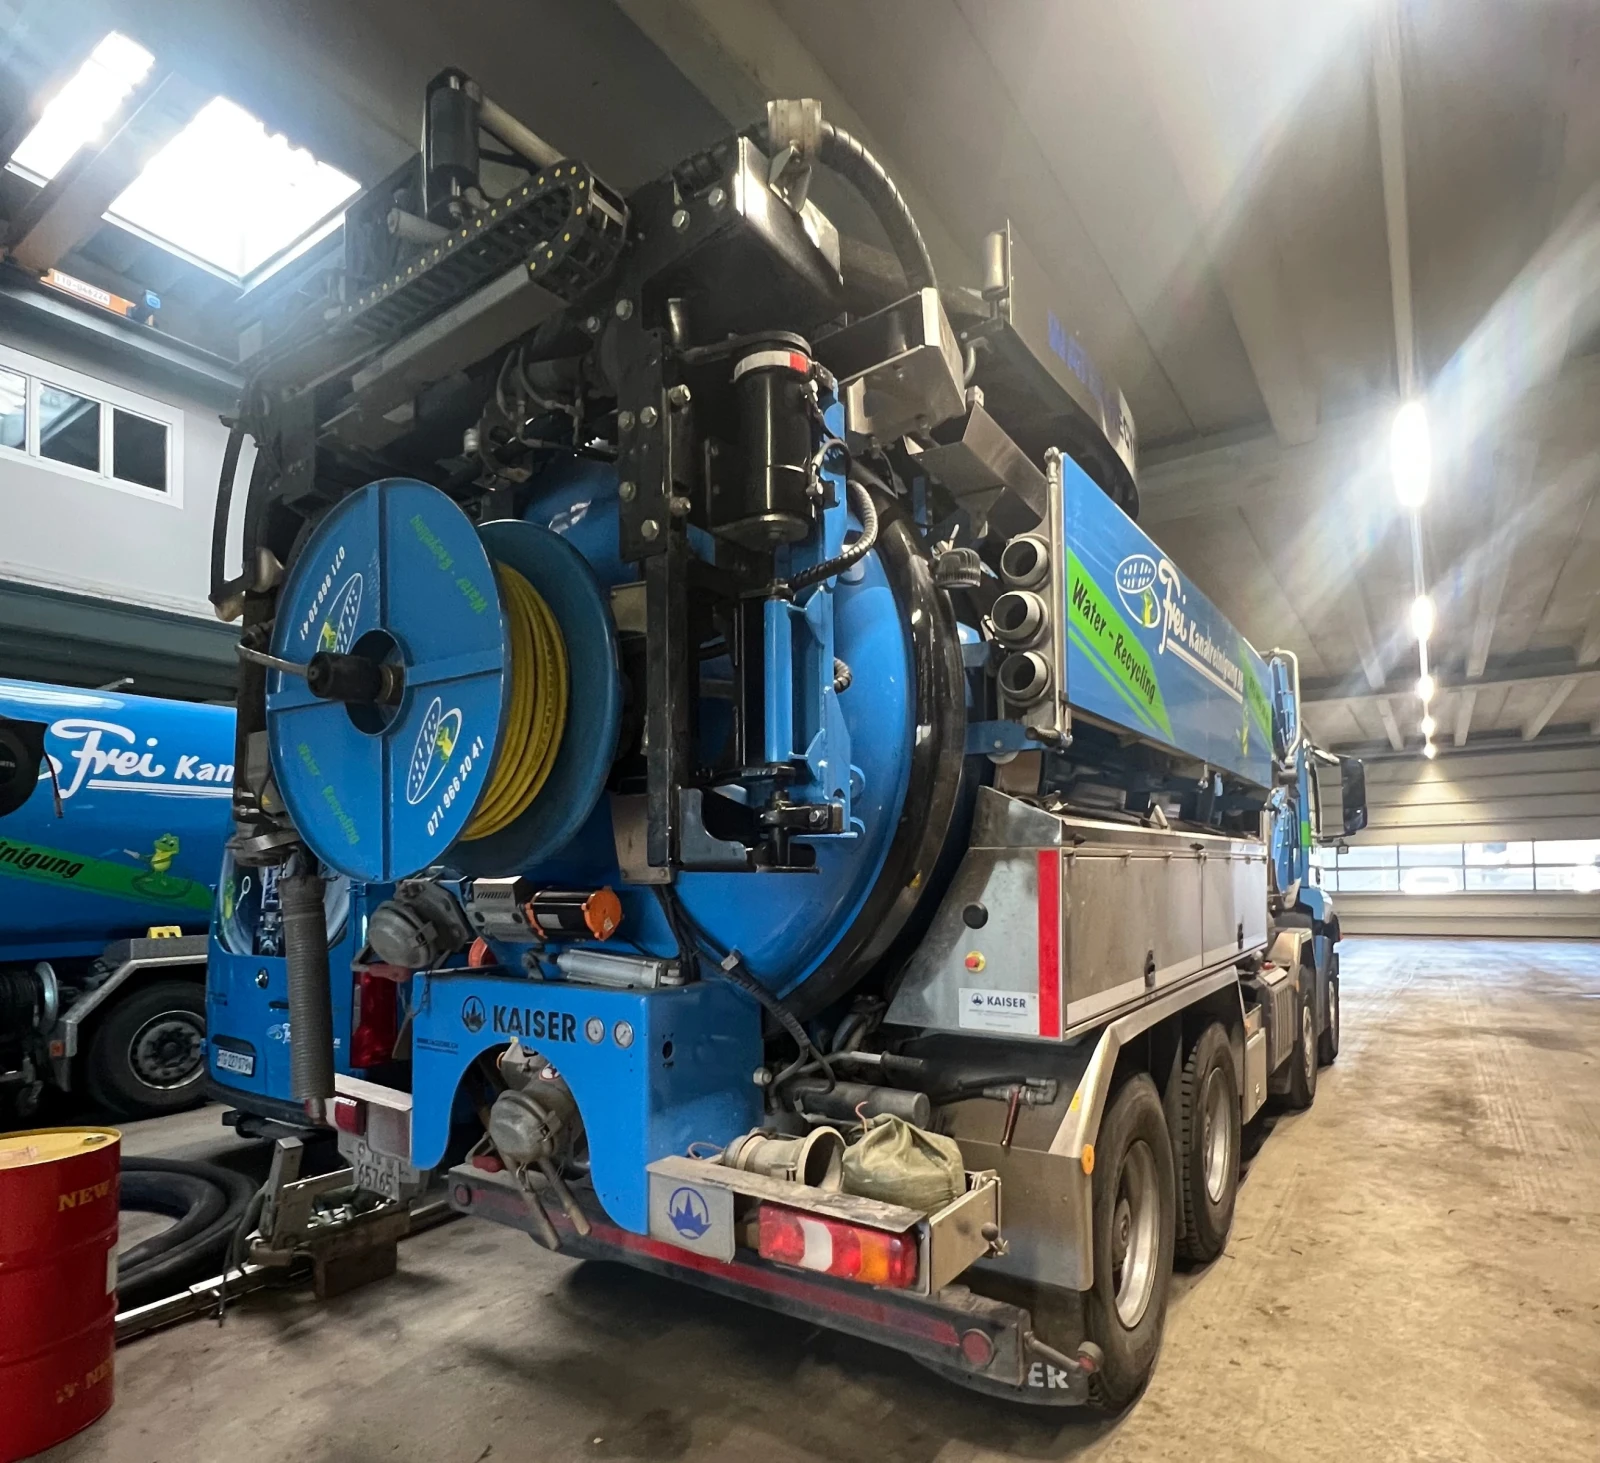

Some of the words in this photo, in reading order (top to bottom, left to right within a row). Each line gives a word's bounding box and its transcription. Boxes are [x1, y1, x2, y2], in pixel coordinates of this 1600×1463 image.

[1072, 577, 1107, 637] Water
[1113, 633, 1156, 705] Recycling
[1158, 558, 1187, 655] Frei
[50, 719, 165, 799] Frei
[427, 805, 444, 836] 071
[443, 776, 461, 809] 966
[460, 755, 472, 781] 20
[472, 736, 484, 759] 41
[493, 1005, 577, 1043] KAISER
[986, 995, 1026, 1008] KAISER
[58, 1179, 110, 1212] NEW
